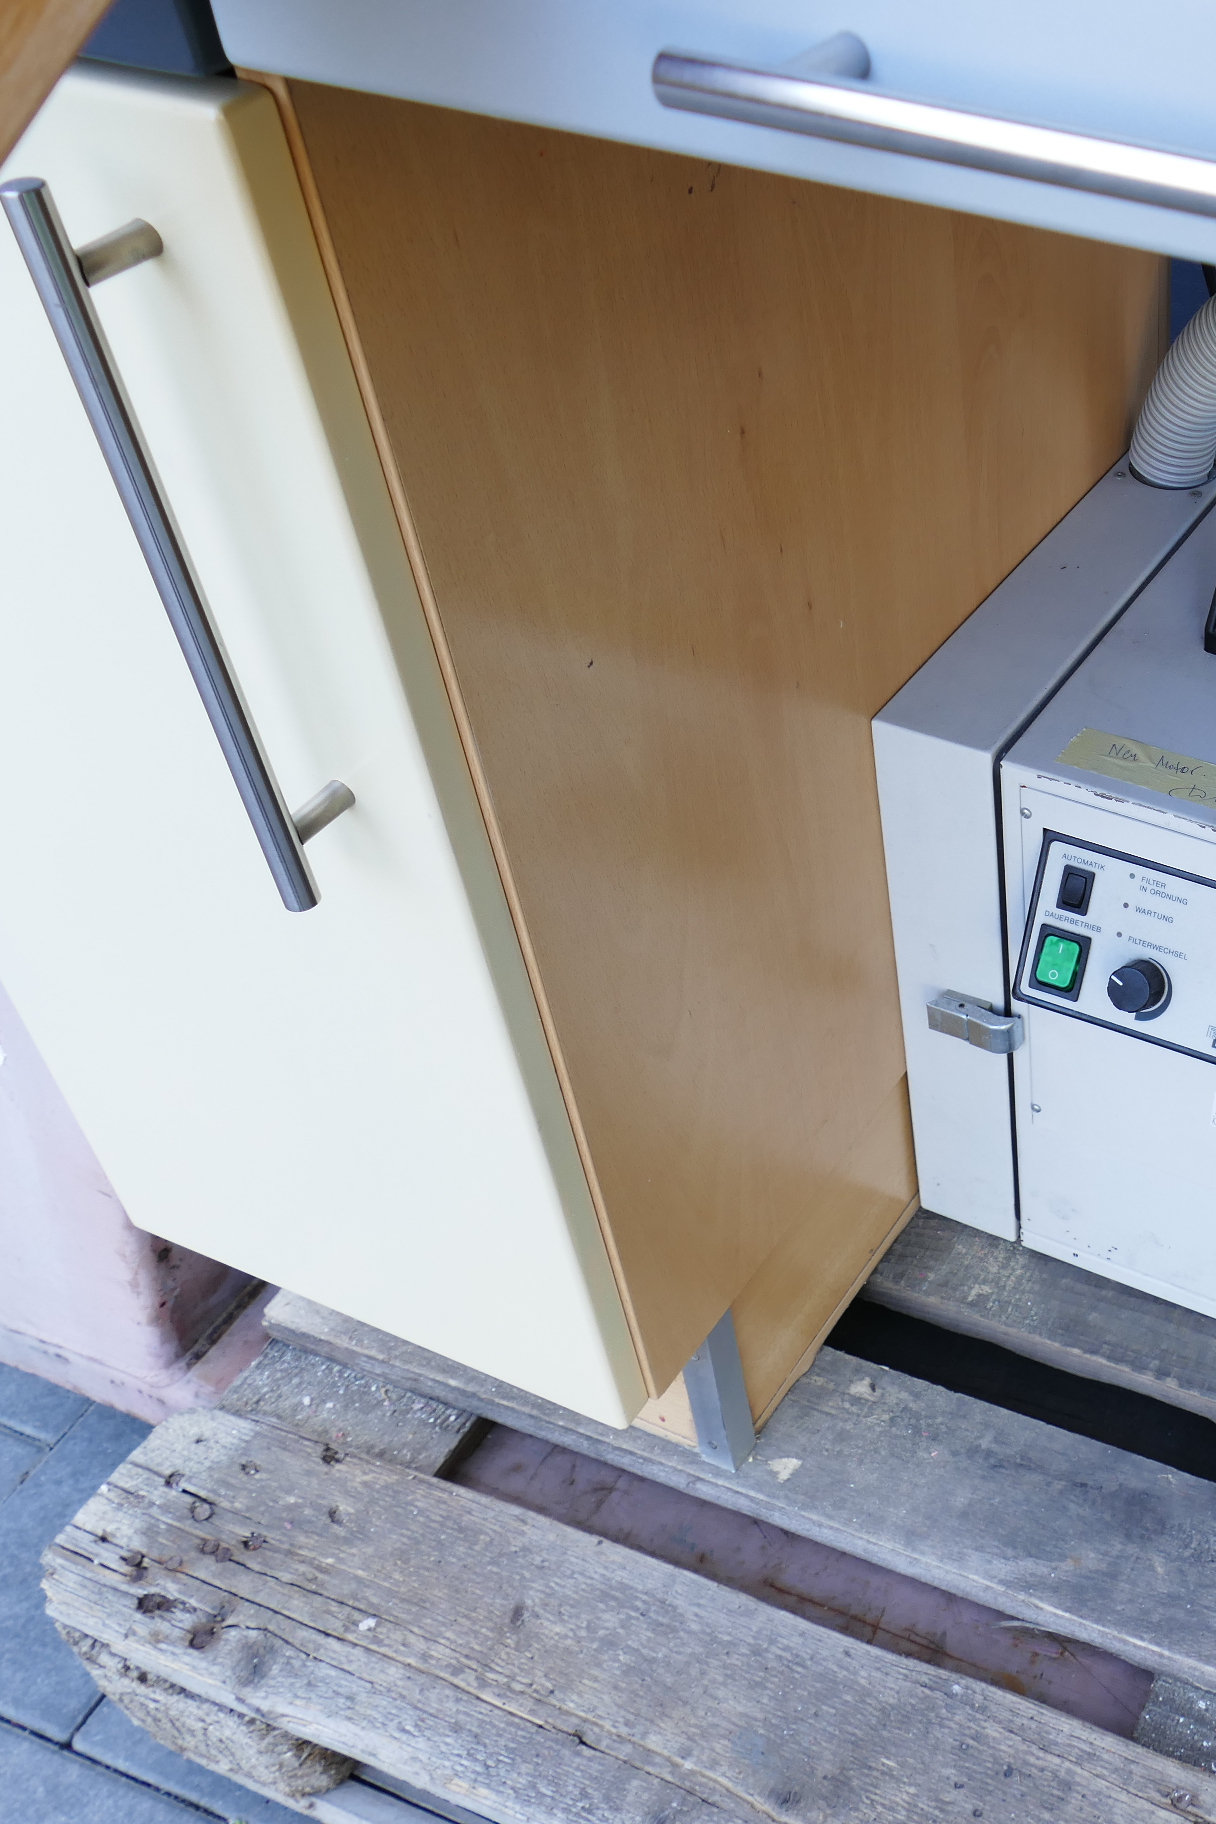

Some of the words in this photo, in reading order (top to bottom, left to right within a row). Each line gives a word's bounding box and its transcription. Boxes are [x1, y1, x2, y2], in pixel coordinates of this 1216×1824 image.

[1061, 853, 1106, 871] AUTOMATIK
[1141, 876, 1167, 890] FILTER
[1139, 885, 1148, 893] IN
[1149, 887, 1188, 906] ORDNUNG
[1044, 910, 1102, 933] DAUERBETRIEB
[1135, 906, 1174, 924] WARTUNG
[1128, 936, 1188, 961] FILTERWECHSEL
